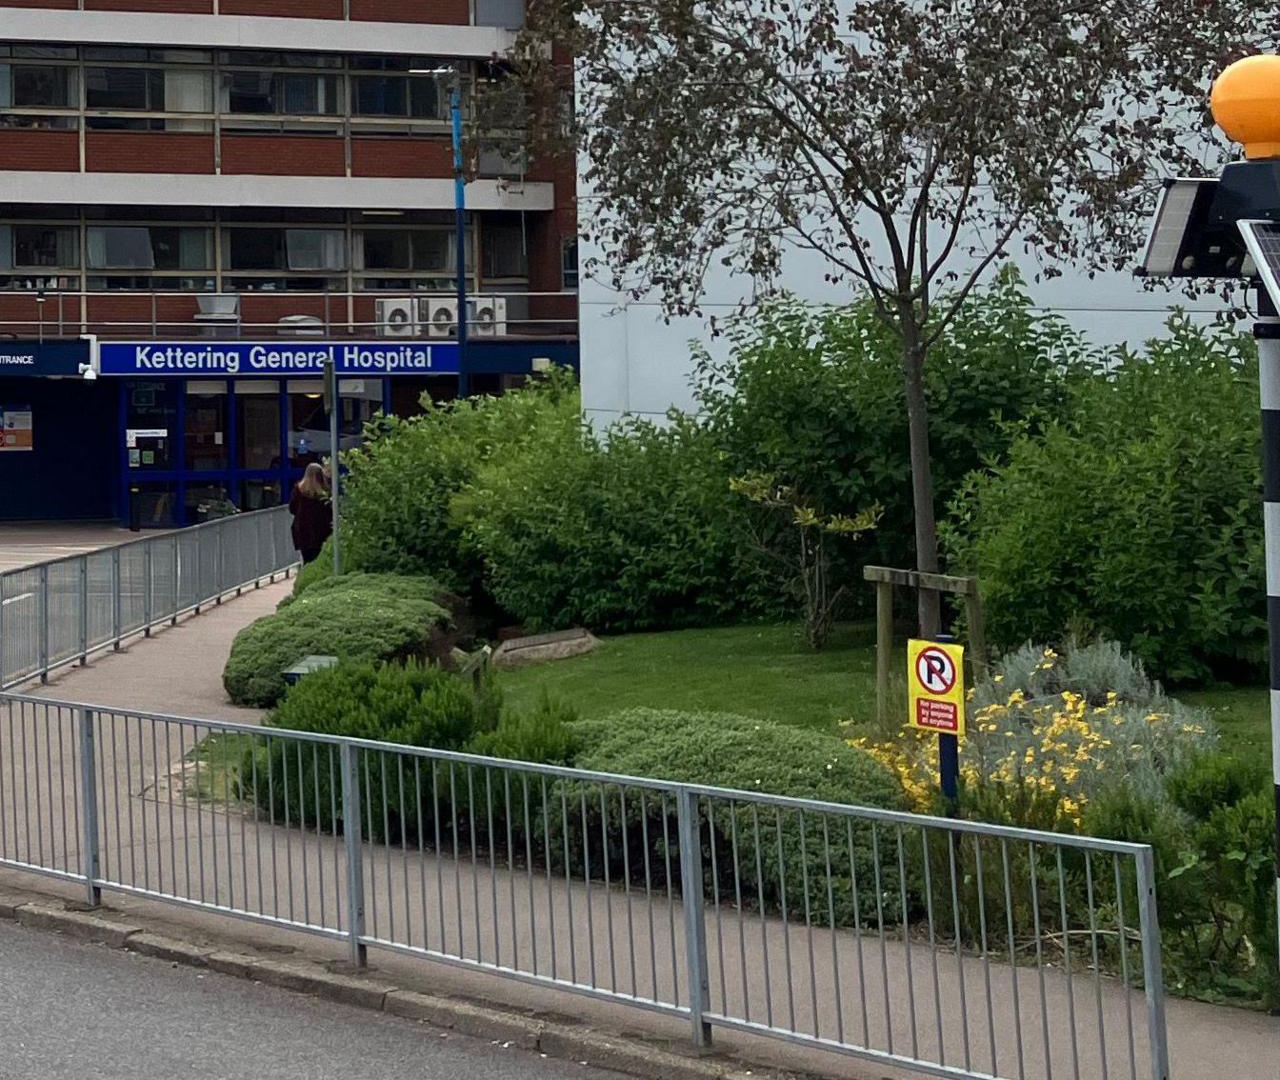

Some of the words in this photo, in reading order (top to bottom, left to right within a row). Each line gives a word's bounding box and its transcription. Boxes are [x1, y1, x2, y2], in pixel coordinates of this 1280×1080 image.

[135, 346, 240, 372] Kettering
[249, 346, 334, 368] General
[344, 346, 432, 371] Hospital
